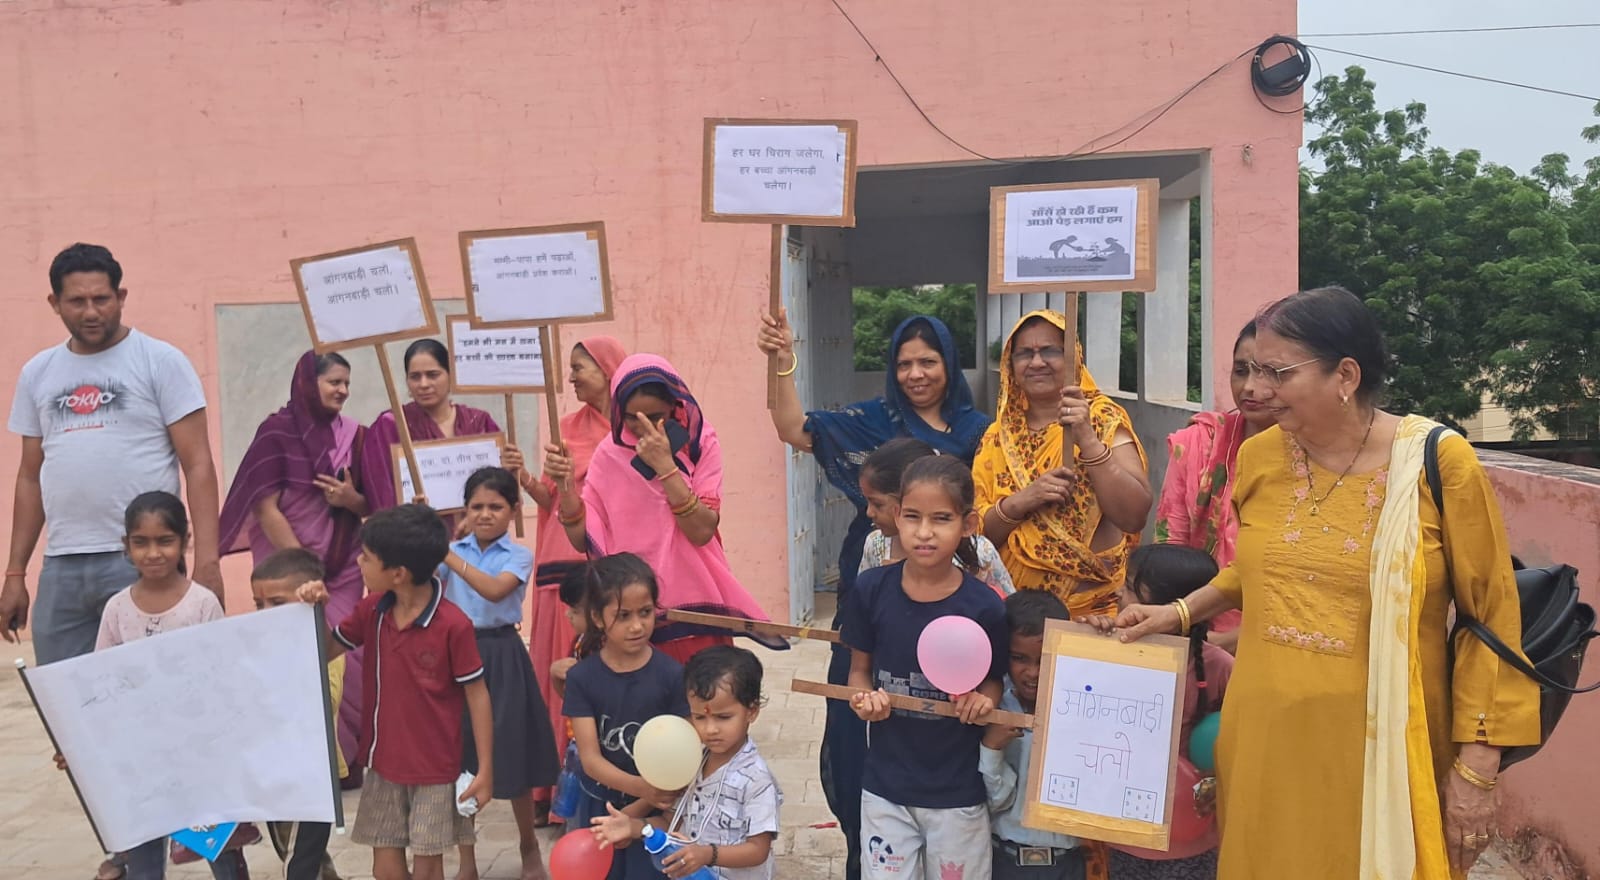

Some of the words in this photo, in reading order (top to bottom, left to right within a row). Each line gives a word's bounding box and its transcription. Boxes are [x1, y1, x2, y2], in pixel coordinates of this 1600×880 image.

[731, 148, 744, 158] हर
[749, 148, 761, 158] घर
[766, 146, 791, 158] चिराग
[739, 166, 750, 175] हर
[1055, 206, 1066, 217] हो
[1069, 205, 1085, 216] रही
[1097, 206, 1119, 215] कम
[1026, 217, 1053, 227] आओ
[1106, 216, 1123, 225] हम
[1074, 731, 1132, 781] चलो
